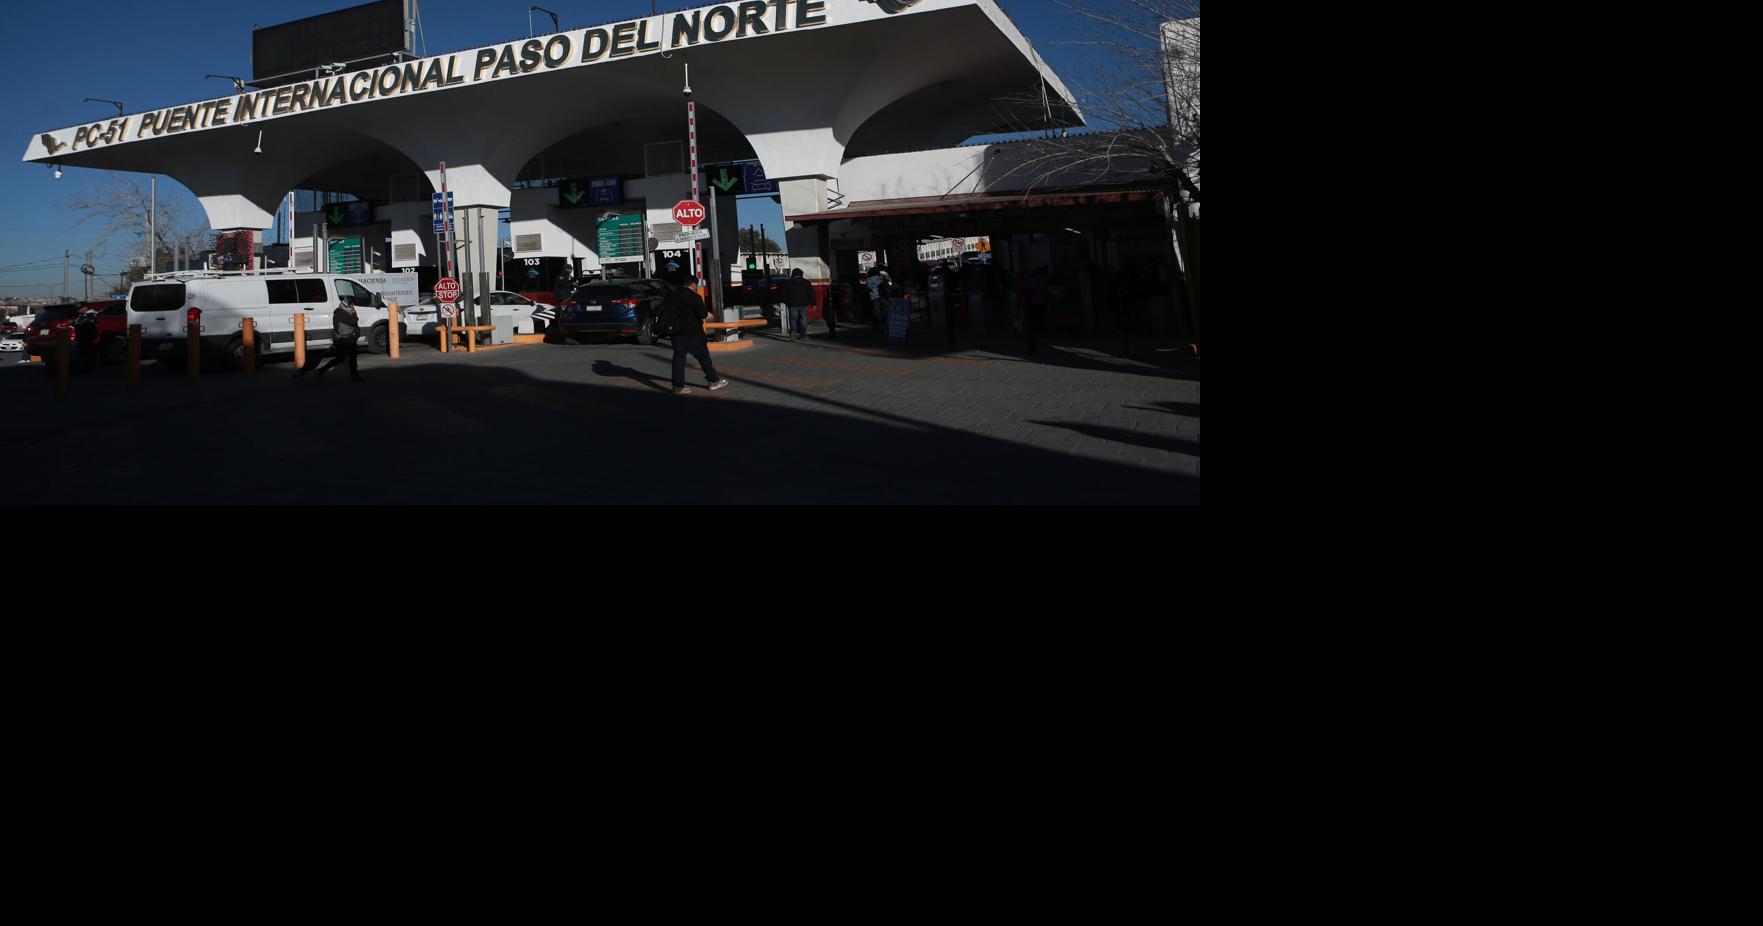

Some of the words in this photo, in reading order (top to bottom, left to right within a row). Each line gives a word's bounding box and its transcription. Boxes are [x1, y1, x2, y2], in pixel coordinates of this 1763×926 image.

[72, 117, 131, 151] PC-51
[137, 98, 232, 139] PUENTE
[231, 55, 465, 123] INTERNACIONAL
[473, 34, 572, 81] PASO
[581, 19, 661, 63] DEL
[670, 0, 828, 48] NORTE
[676, 208, 703, 218] ALTO
[663, 250, 682, 259] 104
[523, 258, 541, 266] 103
[438, 282, 456, 290] ALTO
[438, 291, 458, 299] STOP
